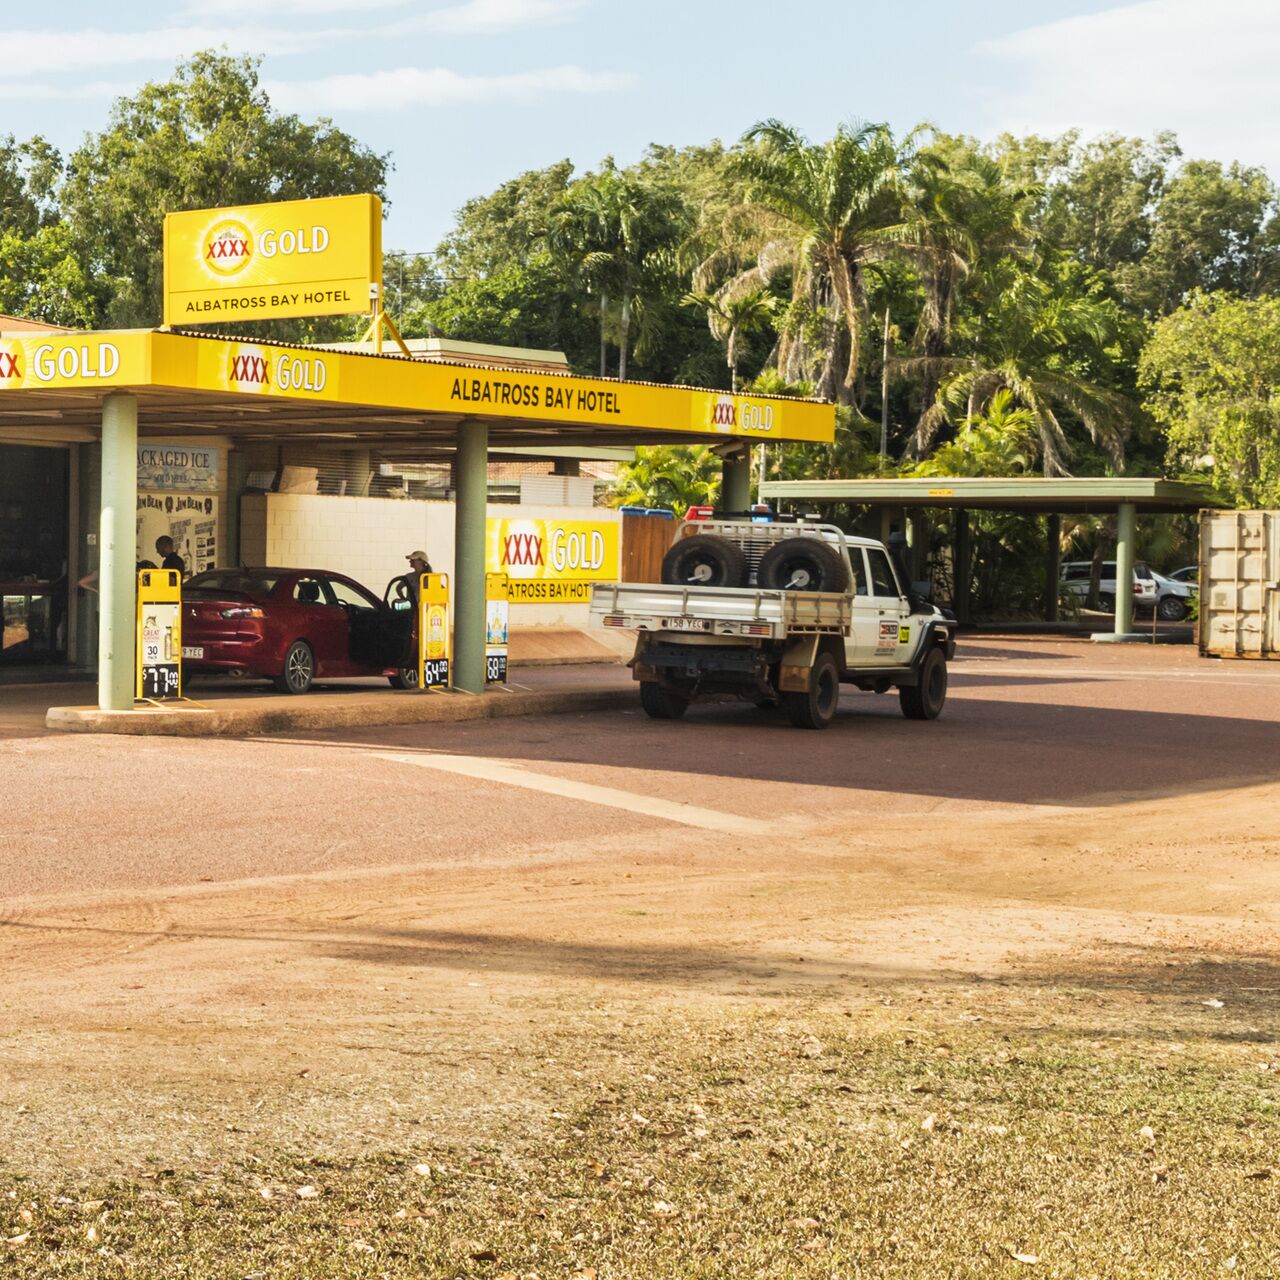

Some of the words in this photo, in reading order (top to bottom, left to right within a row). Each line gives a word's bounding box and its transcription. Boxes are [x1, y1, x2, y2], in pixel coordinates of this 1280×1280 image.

[206, 240, 251, 259] XXXX
[259, 226, 330, 258] GOLD
[186, 297, 266, 312] ALBATROSS
[271, 294, 300, 306] BAY
[304, 290, 351, 304] HOTEL
[33, 343, 120, 382] GOLD
[229, 355, 269, 384] XXXX
[277, 354, 326, 391] GOLD
[450, 378, 540, 407] ALBATROSS
[545, 387, 574, 409] BAY
[577, 389, 621, 414] HOTEL
[711, 404, 737, 426] XXXX
[742, 402, 773, 431] GOLD
[191, 453, 210, 468] ICE
[501, 534, 544, 566] XXXX
[552, 528, 604, 572] GOLD
[508, 584, 546, 598] ATROSS
[550, 584, 569, 597] BAY
[571, 584, 590, 598] HOT
[147, 646, 158, 655] 30
[188, 648, 202, 656] YEC
